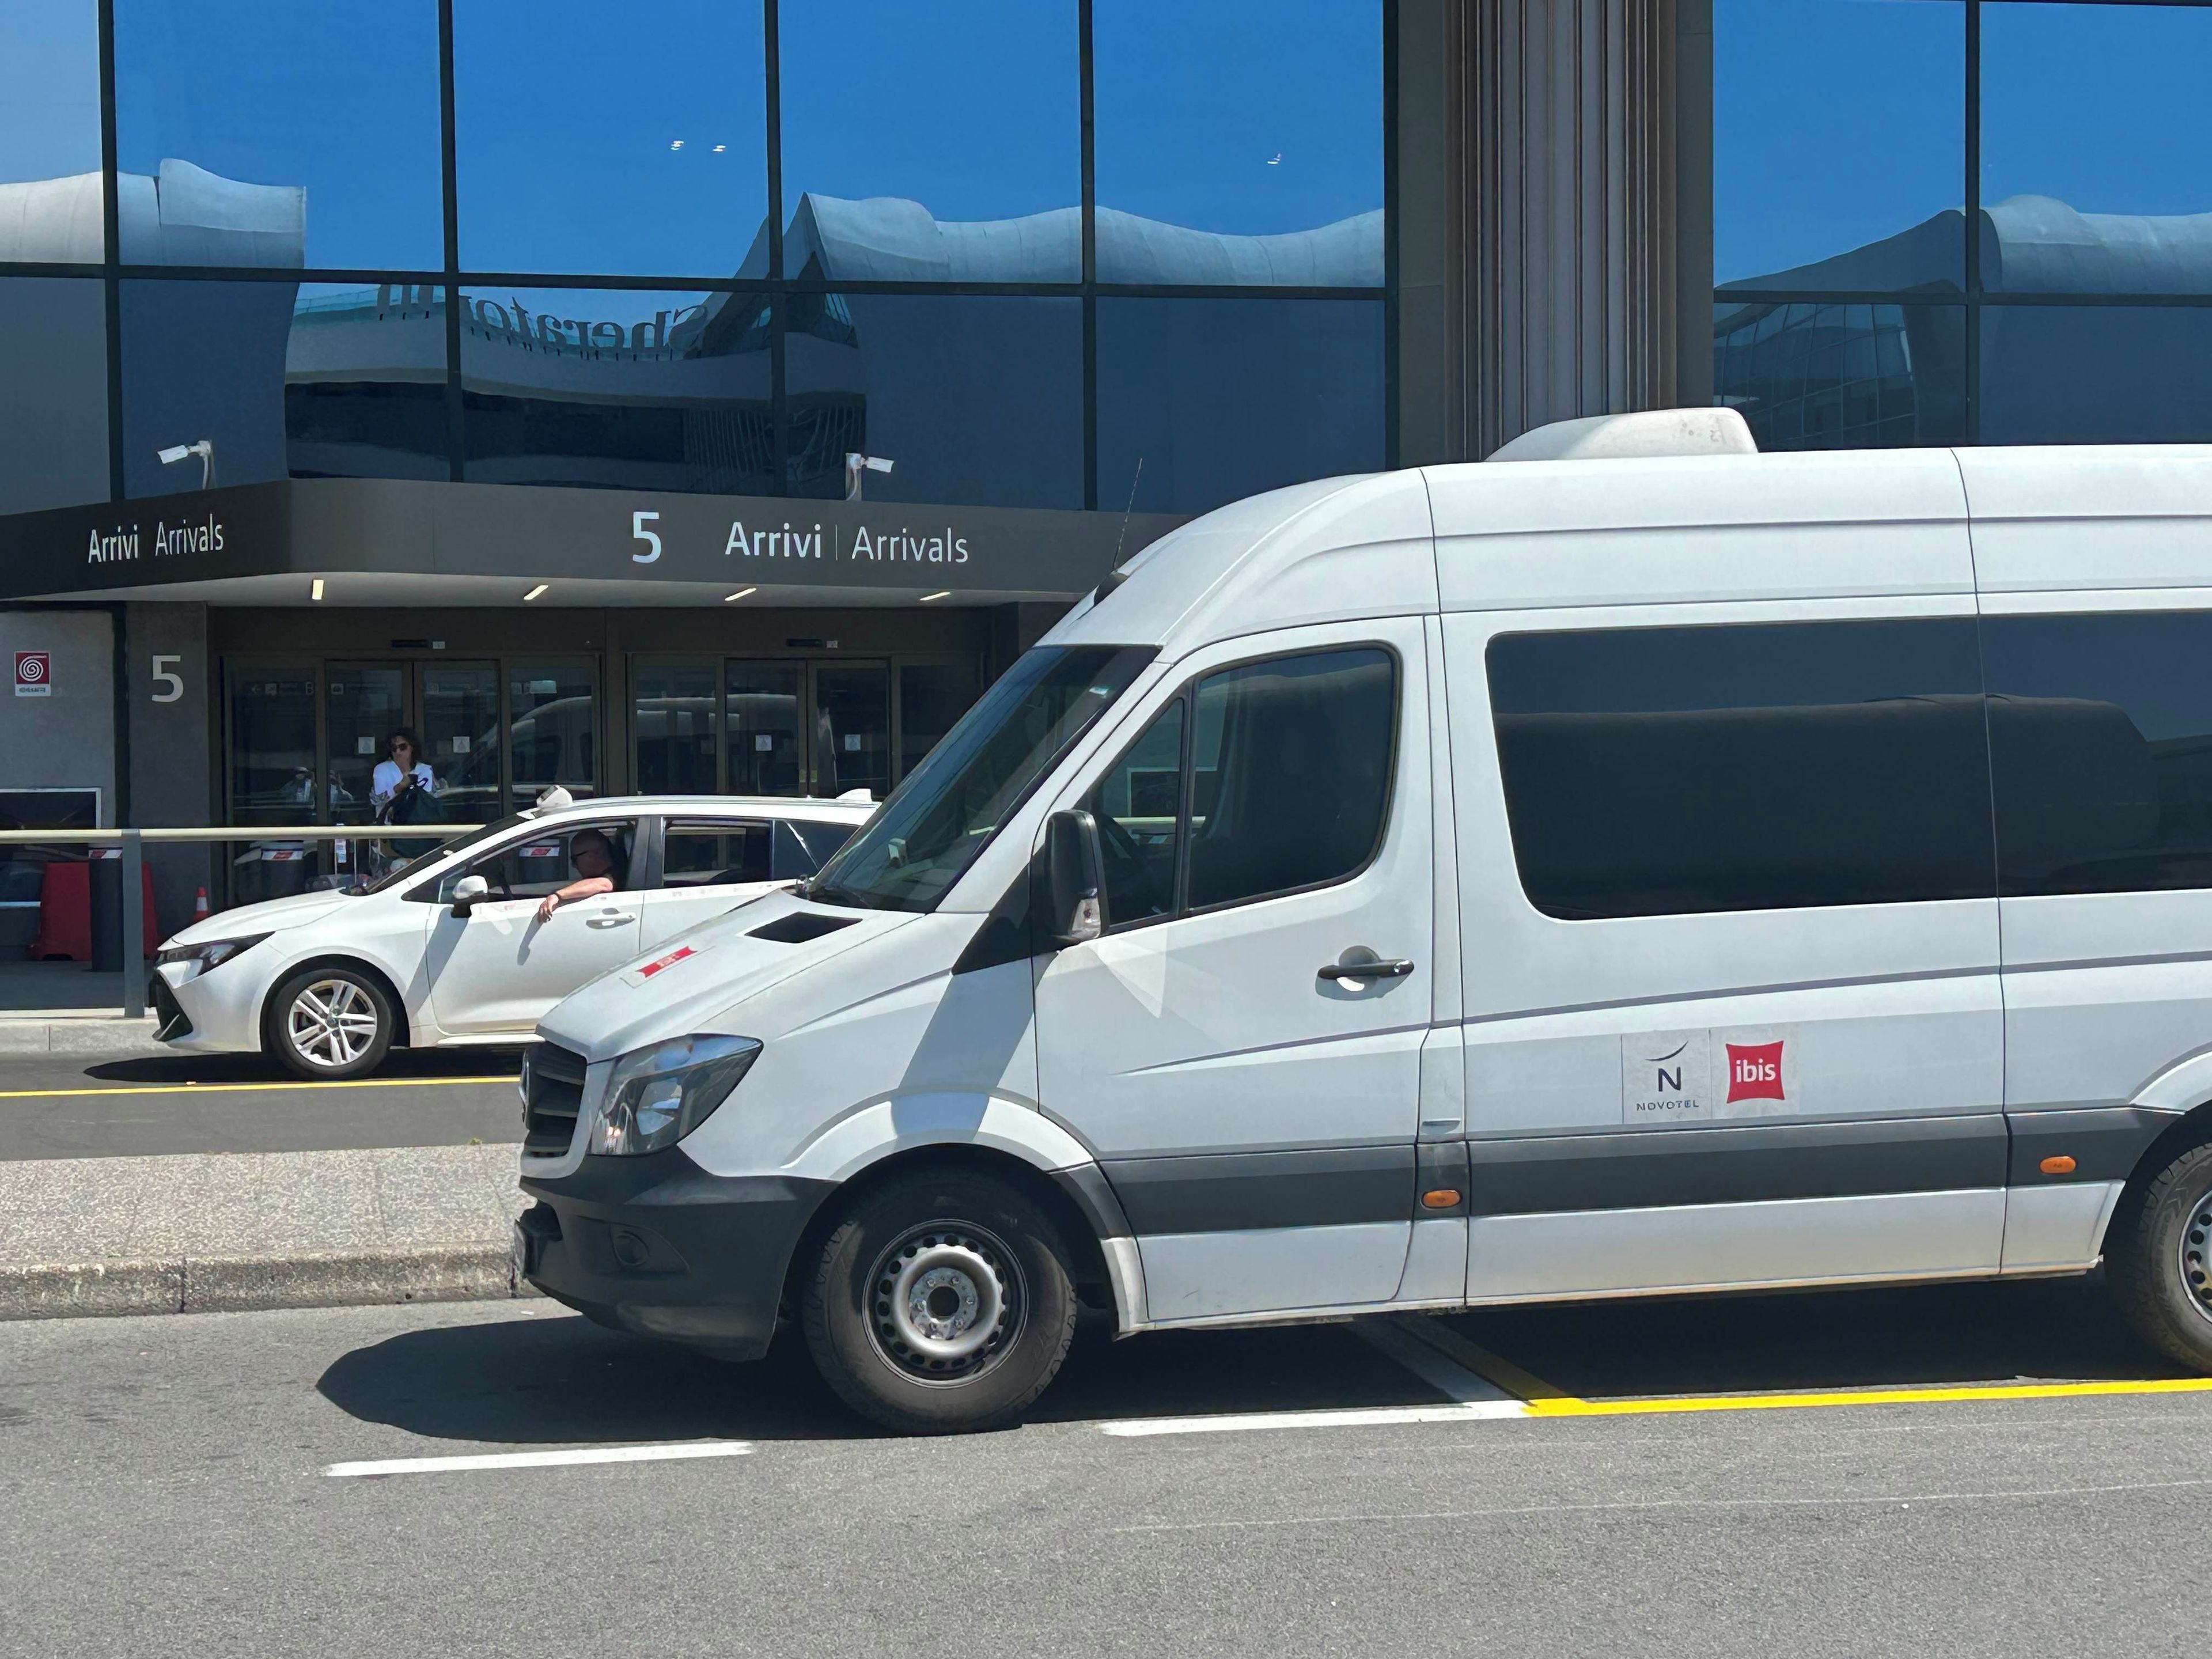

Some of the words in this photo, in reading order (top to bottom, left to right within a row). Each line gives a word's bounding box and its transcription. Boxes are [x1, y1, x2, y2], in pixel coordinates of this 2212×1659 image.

[88, 524, 138, 563] Arrivi
[155, 513, 224, 556] Arrivals
[632, 512, 662, 563] 5
[725, 521, 821, 558] Arrivi
[851, 527, 969, 563] Arrivals
[151, 655, 183, 702] 5
[1658, 1066, 1681, 1092] N
[1736, 1058, 1776, 1083] ibis
[1637, 1100, 1699, 1111] NOVOTEL
